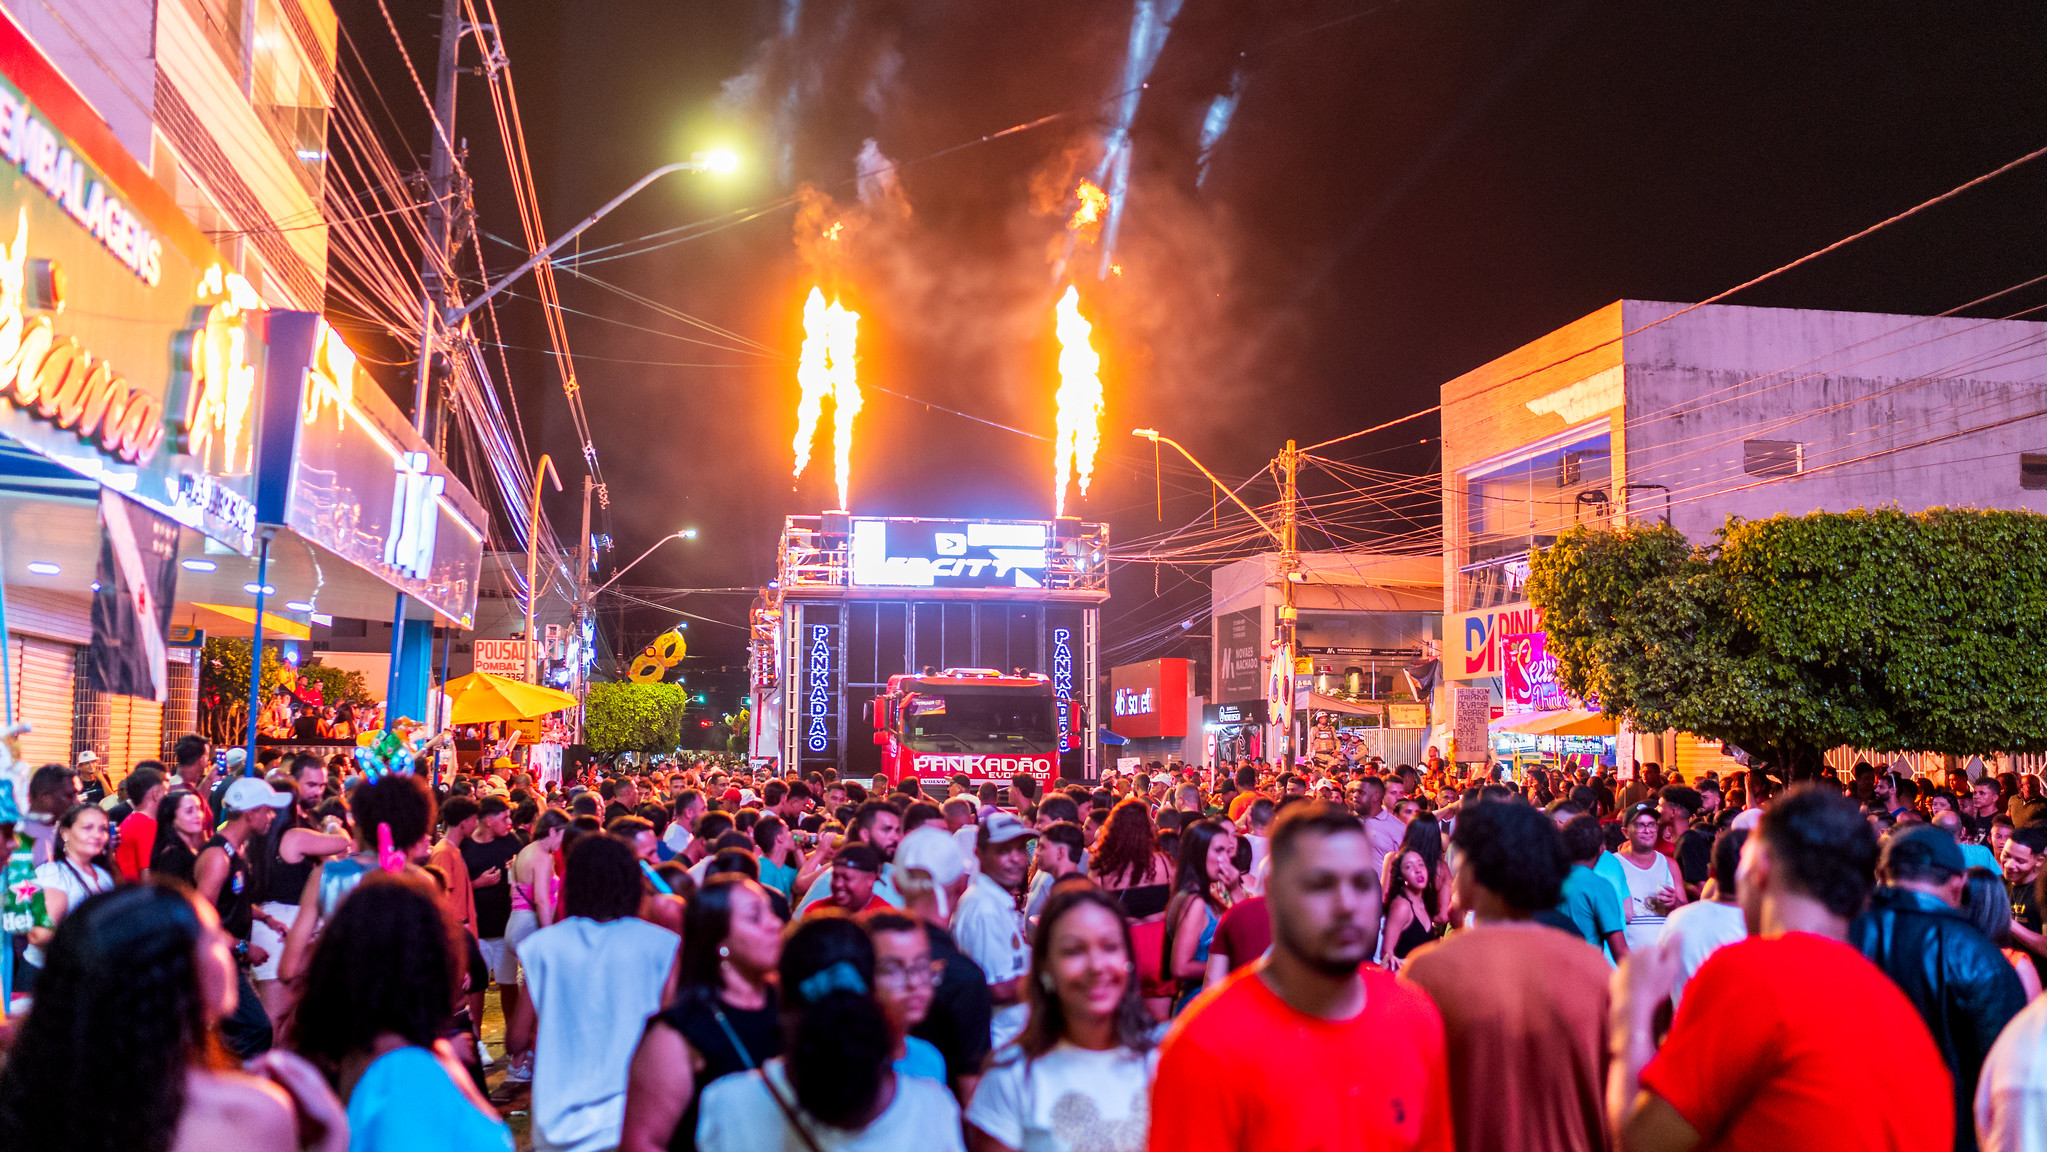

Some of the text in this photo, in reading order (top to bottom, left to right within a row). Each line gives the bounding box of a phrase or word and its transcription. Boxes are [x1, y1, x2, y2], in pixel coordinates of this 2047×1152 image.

[809, 624, 829, 752] PANKADÃO
[1458, 701, 1489, 709] DEVASSA
[913, 755, 1051, 775] PANKADÃO
